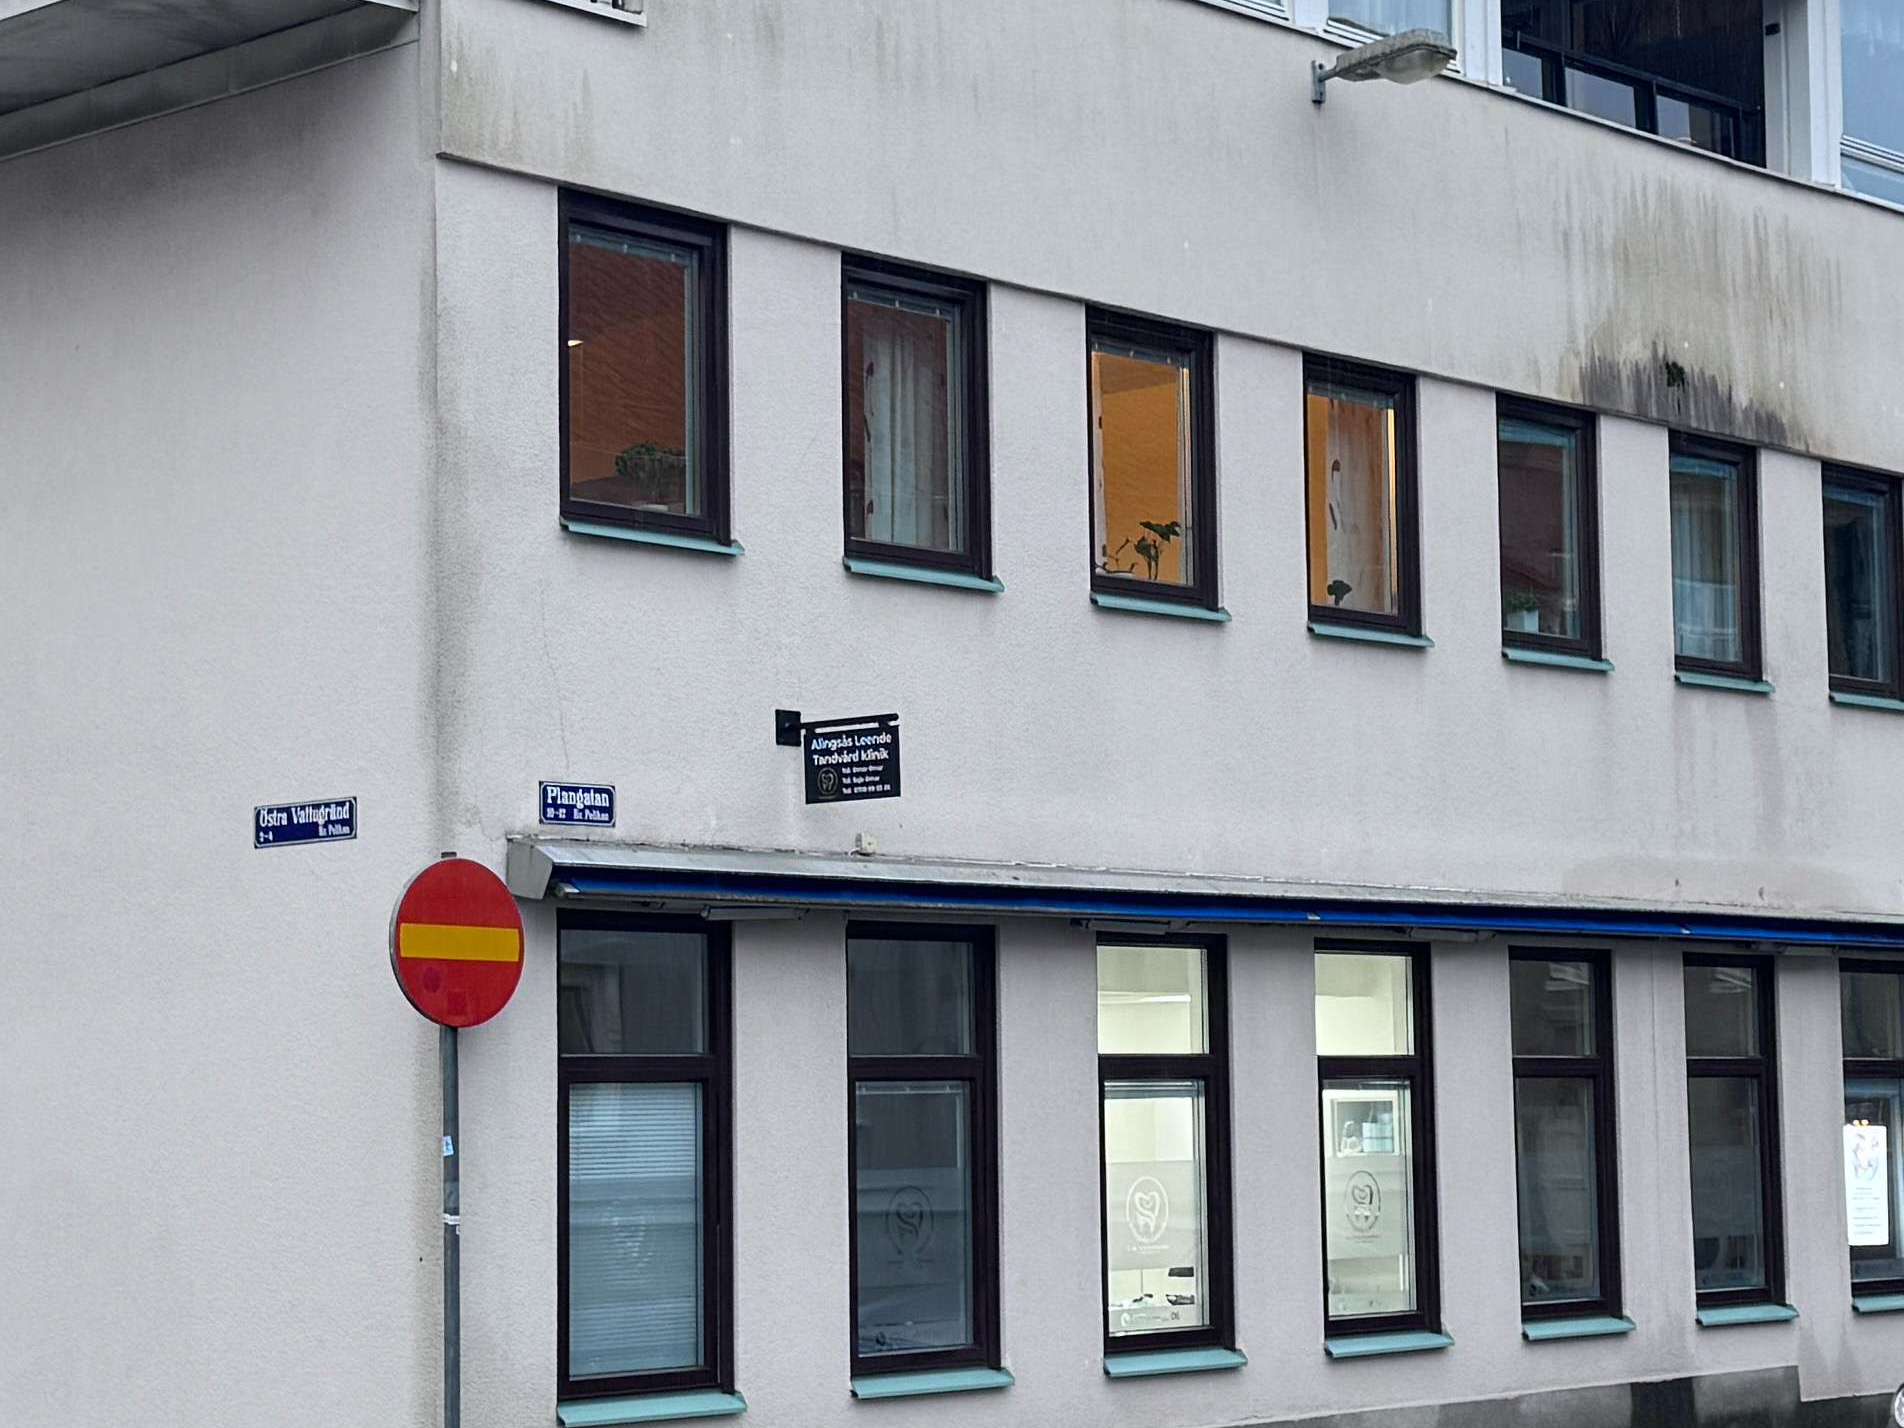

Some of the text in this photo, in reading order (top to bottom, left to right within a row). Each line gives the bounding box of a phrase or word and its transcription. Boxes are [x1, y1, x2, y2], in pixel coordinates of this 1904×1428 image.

[811, 732, 892, 750] Alingsås Leende
[813, 750, 859, 765] Tandvård
[546, 786, 609, 809] Plangatan
[259, 807, 287, 827] Östra
